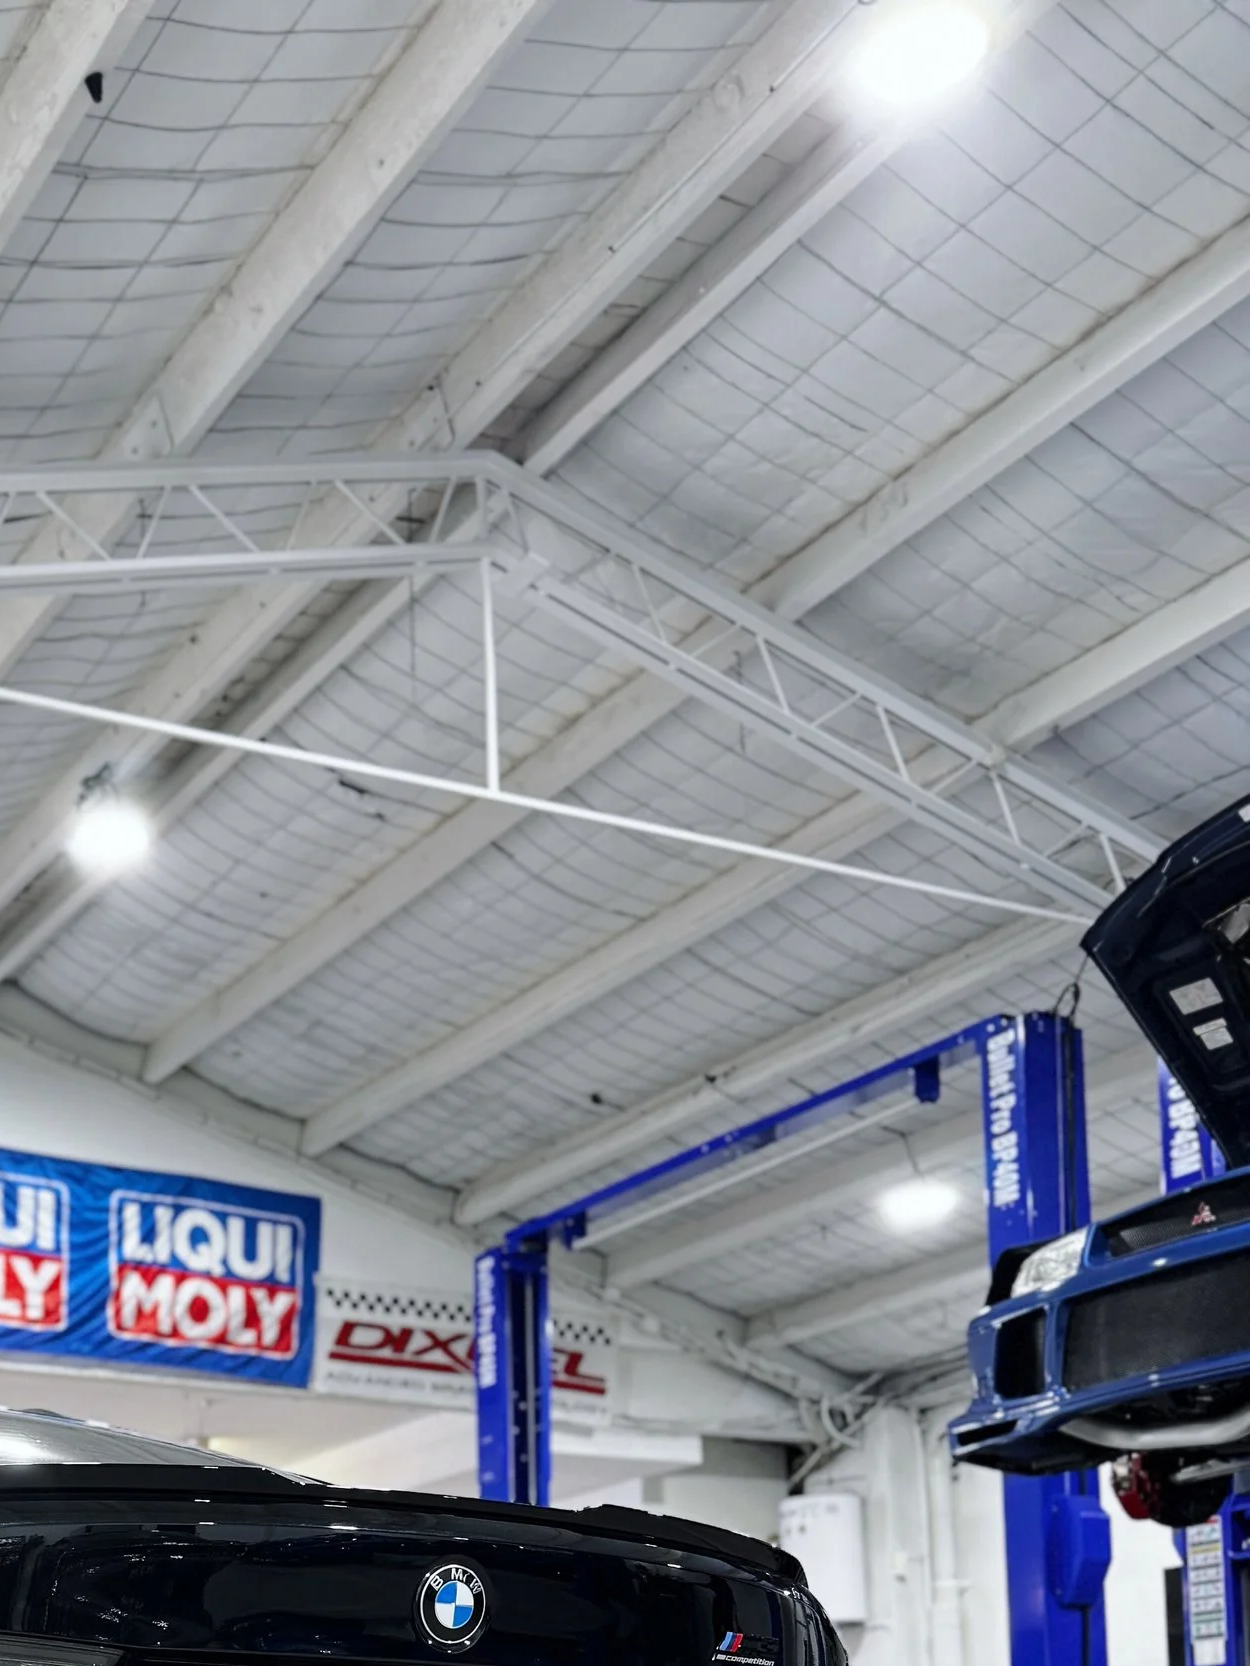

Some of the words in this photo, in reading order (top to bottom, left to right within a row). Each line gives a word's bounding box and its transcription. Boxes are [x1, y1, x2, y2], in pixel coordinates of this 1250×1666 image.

[990, 1092, 1017, 1135] Pro
[121, 1201, 294, 1284] LIQUI
[118, 1270, 299, 1349] MOLY
[333, 1321, 606, 1384] DIXL
[430, 1567, 482, 1595] BMW
[725, 1655, 775, 1666] competition
